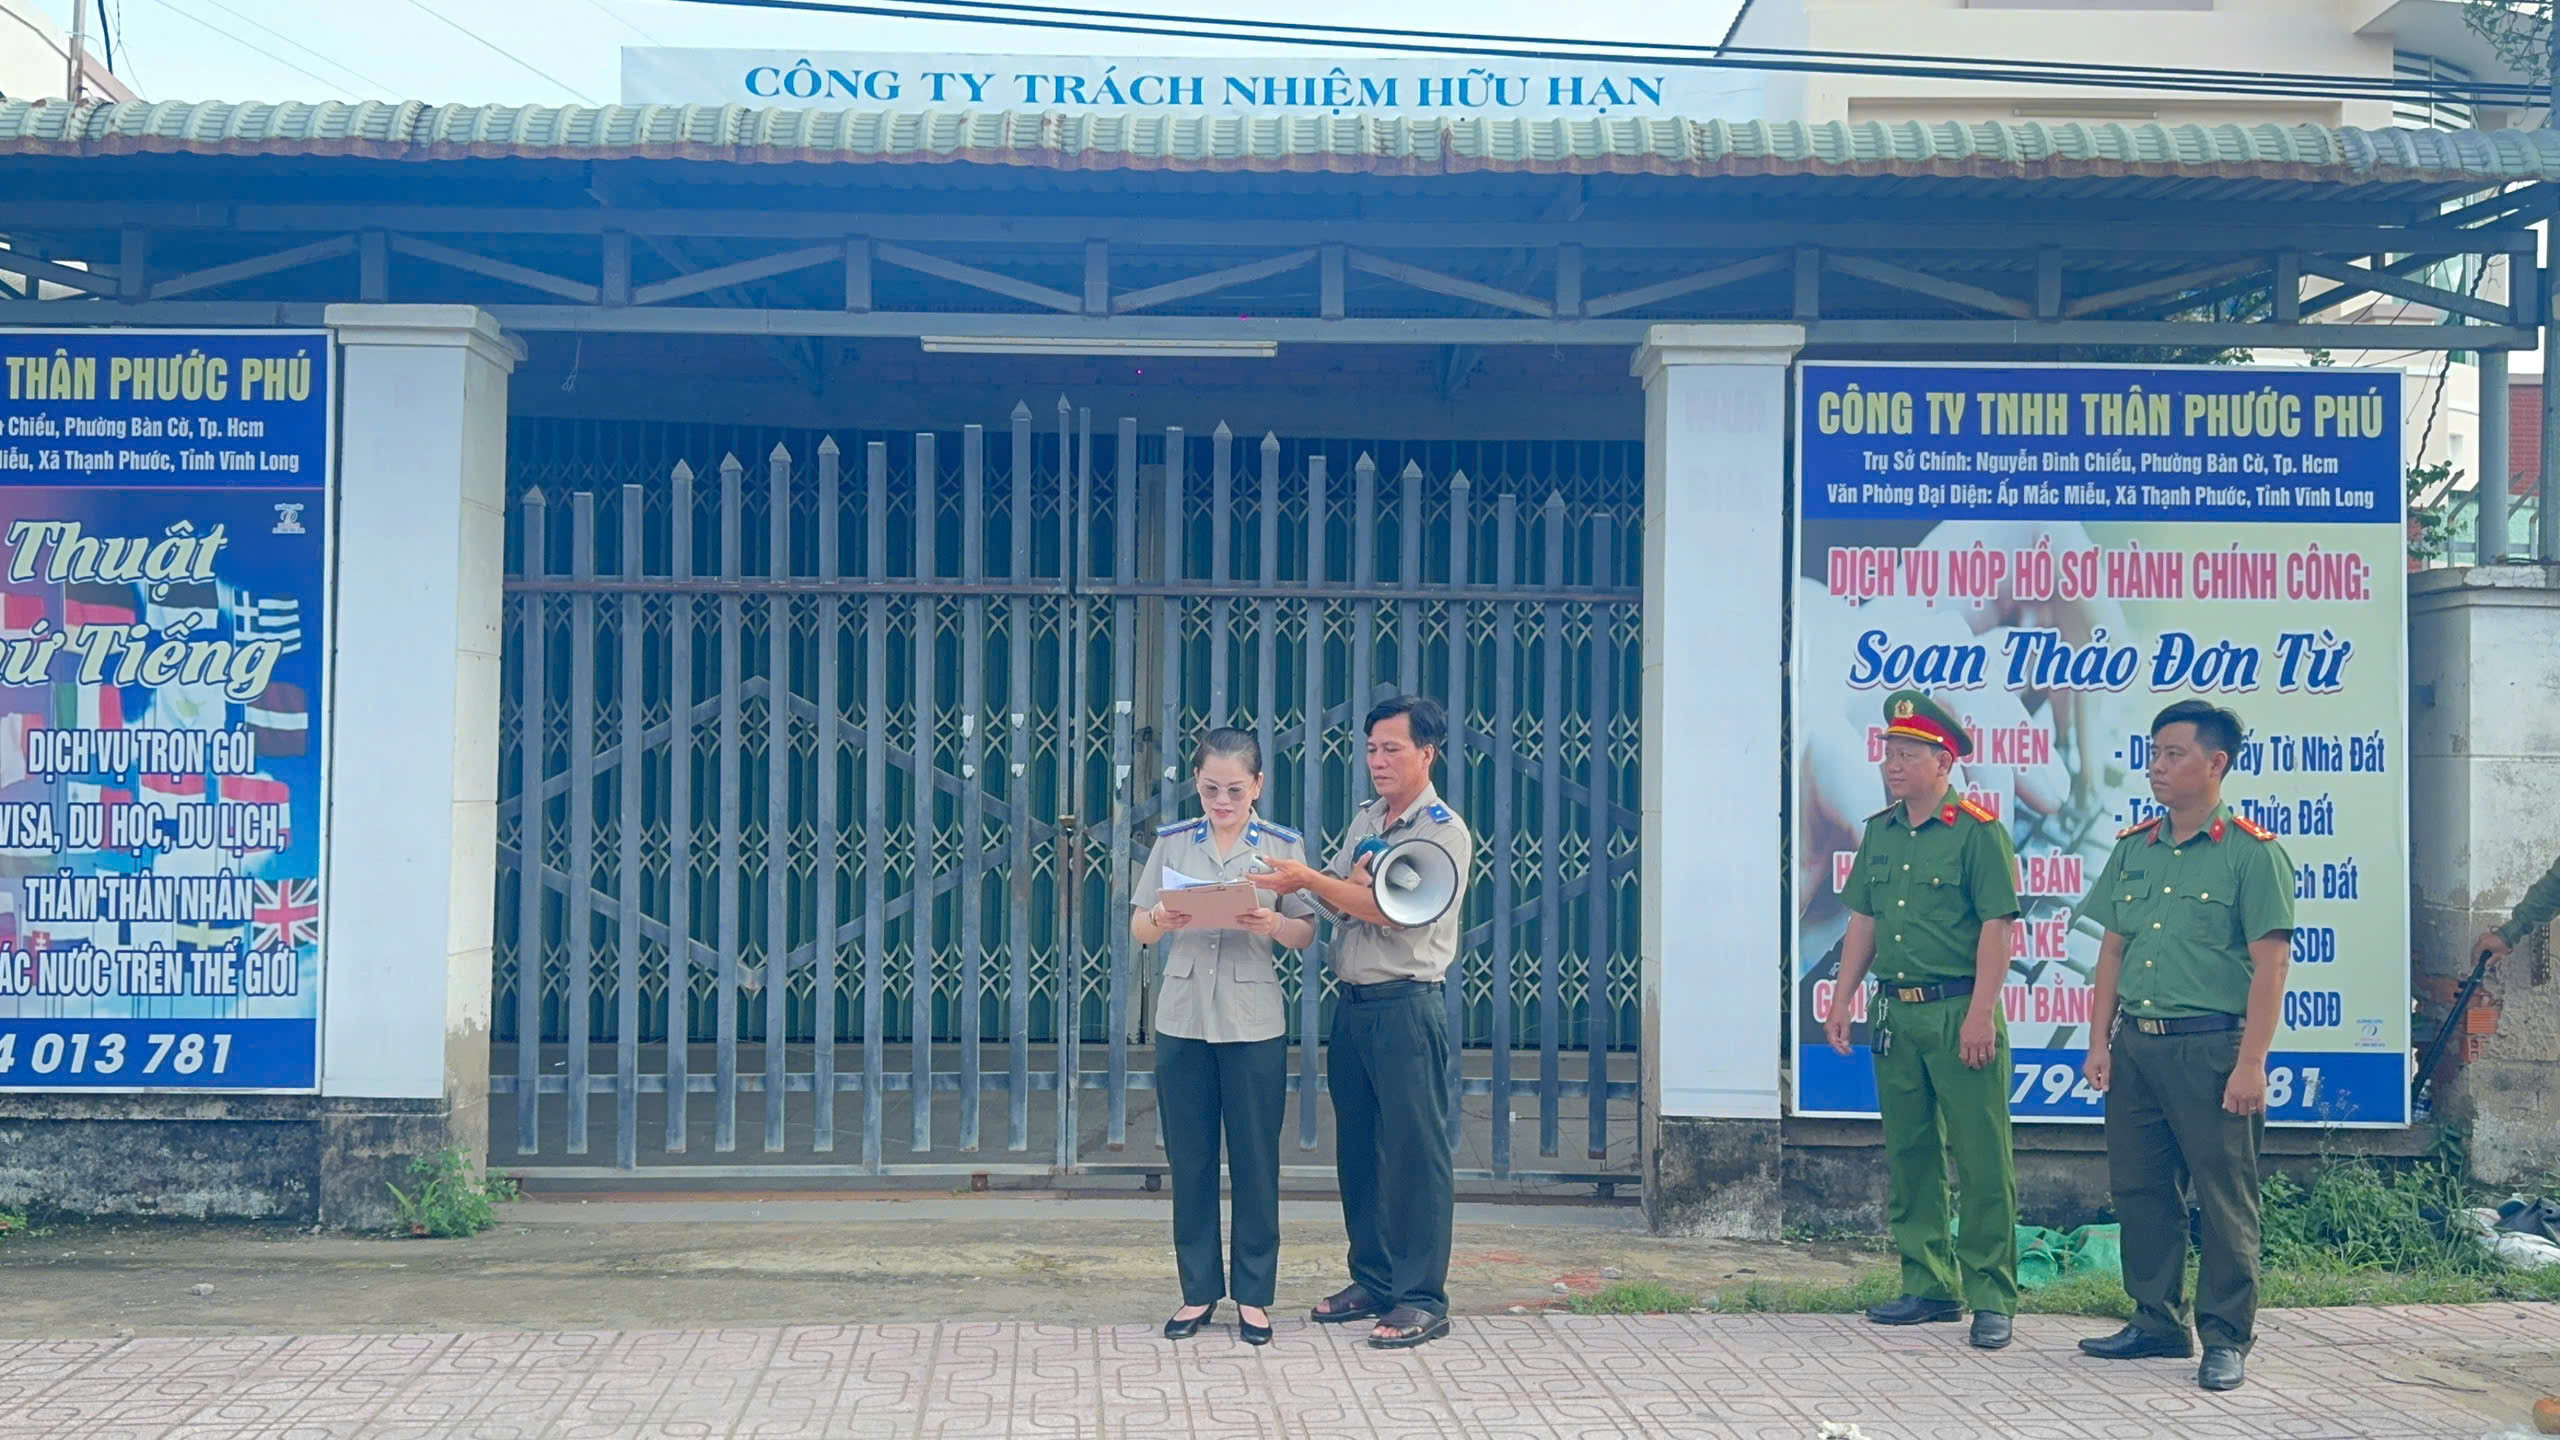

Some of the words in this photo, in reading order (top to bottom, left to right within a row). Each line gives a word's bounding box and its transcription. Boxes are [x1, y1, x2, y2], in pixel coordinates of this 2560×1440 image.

[745, 58, 900, 101] CÔNG
[921, 72, 996, 102] TY
[1013, 65, 1205, 105] TRÁCH
[1223, 66, 1399, 115] NHIỆM
[1417, 68, 1531, 107] HỮU
[1547, 76, 1665, 114] HẠN
[6, 348, 96, 400] THÂN
[110, 349, 228, 401] PHƯỚC
[241, 349, 311, 401] PHÚ
[8, 412, 60, 439] Chiểu,
[65, 416, 126, 439] Phường
[131, 416, 162, 437] Bàn
[167, 416, 194, 439] Cờ,
[198, 417, 222, 439] Tp.
[227, 417, 264, 437] Hcm
[1818, 383, 1913, 435] CÔNG
[1926, 392, 1966, 435] TY
[1977, 393, 2068, 436] TNHH
[2081, 384, 2171, 437] THÂN
[2184, 386, 2301, 438] PHƯỚC
[2314, 387, 2383, 439] PHÚ
[38, 450, 60, 470] Xã
[64, 450, 114, 475] Thạnh
[119, 449, 175, 472] Phước,
[180, 448, 214, 470] Tỉnh
[219, 450, 255, 470] Vĩnh
[260, 451, 299, 473] Long
[1863, 451, 1889, 475] Trụ
[1893, 449, 1915, 471] Sở
[1919, 450, 1972, 471] Chính:
[1976, 449, 2038, 474] Nguyễn
[2042, 451, 2079, 472] Đình
[2084, 448, 2137, 474] Chiểu,
[2141, 452, 2201, 475] Phường
[2207, 452, 2238, 473] Bàn
[2243, 452, 2269, 475] Cờ,
[2273, 453, 2298, 476] Tp.
[2302, 453, 2338, 474] Hcm
[1827, 483, 1857, 503] Văn
[1862, 483, 1913, 506] Phòng
[1918, 484, 1945, 508] Đại
[1950, 484, 1992, 508] Diện:
[1996, 477, 2016, 507] Ấp
[2023, 481, 2059, 505] Mắc
[2064, 481, 2110, 507] Miễu,
[2115, 485, 2136, 506] Xã
[2141, 485, 2190, 510] Thạnh
[2195, 485, 2251, 508] Phước,
[2256, 485, 2290, 507] Tỉnh
[2295, 487, 2330, 507] Vĩnh
[2335, 487, 2374, 509] Long
[6, 520, 229, 602] Thuật
[1830, 549, 1895, 607] DỊCH
[1903, 549, 1939, 608] VỤ
[1949, 540, 2006, 608] NỘP
[2015, 534, 2052, 599] HỒ
[2060, 546, 2099, 599] SƠ
[2107, 541, 2183, 598] HÀNH
[2193, 542, 2277, 599] CHÍNH
[2286, 542, 2370, 600] CÔNG:
[75, 612, 283, 700] Tiếng
[1849, 629, 1987, 697] Soạn
[2003, 628, 2140, 688] Thảo
[2151, 631, 2260, 690] Đơn
[2275, 628, 2352, 691] Từ
[28, 729, 91, 784] DỊCH
[96, 729, 130, 784] VỤ
[136, 729, 208, 784] TRỌN
[211, 722, 255, 775] GÓI
[1992, 721, 2049, 773] KIỆN
[2270, 736, 2296, 771] Tờ
[2302, 736, 2343, 771] Nhà
[2350, 730, 2385, 772] Đất
[0, 802, 61, 852] VISA,
[67, 802, 103, 848] DU
[111, 802, 171, 857] HỌC,
[178, 803, 213, 848] DU
[218, 803, 286, 857] LỊCH,
[2241, 795, 2292, 835] Thửa
[2298, 793, 2334, 836] Đất
[25, 868, 98, 921] THĂM
[104, 868, 174, 922] THÂN
[180, 867, 254, 922] NHÂN
[2030, 849, 2081, 894] BÁN
[2323, 856, 2358, 899] Đất
[2035, 909, 2066, 957] KẾ
[2289, 926, 2335, 963] SDĐ
[0, 942, 31, 996] ÁC
[38, 941, 110, 996] NƯỚC
[116, 943, 182, 996] TRÊN
[190, 936, 238, 996] THẾ
[244, 944, 298, 996] GIỚI
[2003, 987, 2026, 1022] VI
[2284, 991, 2341, 1030] QSDĐ
[31, 1033, 127, 1074] 013
[143, 1033, 232, 1074] 781
